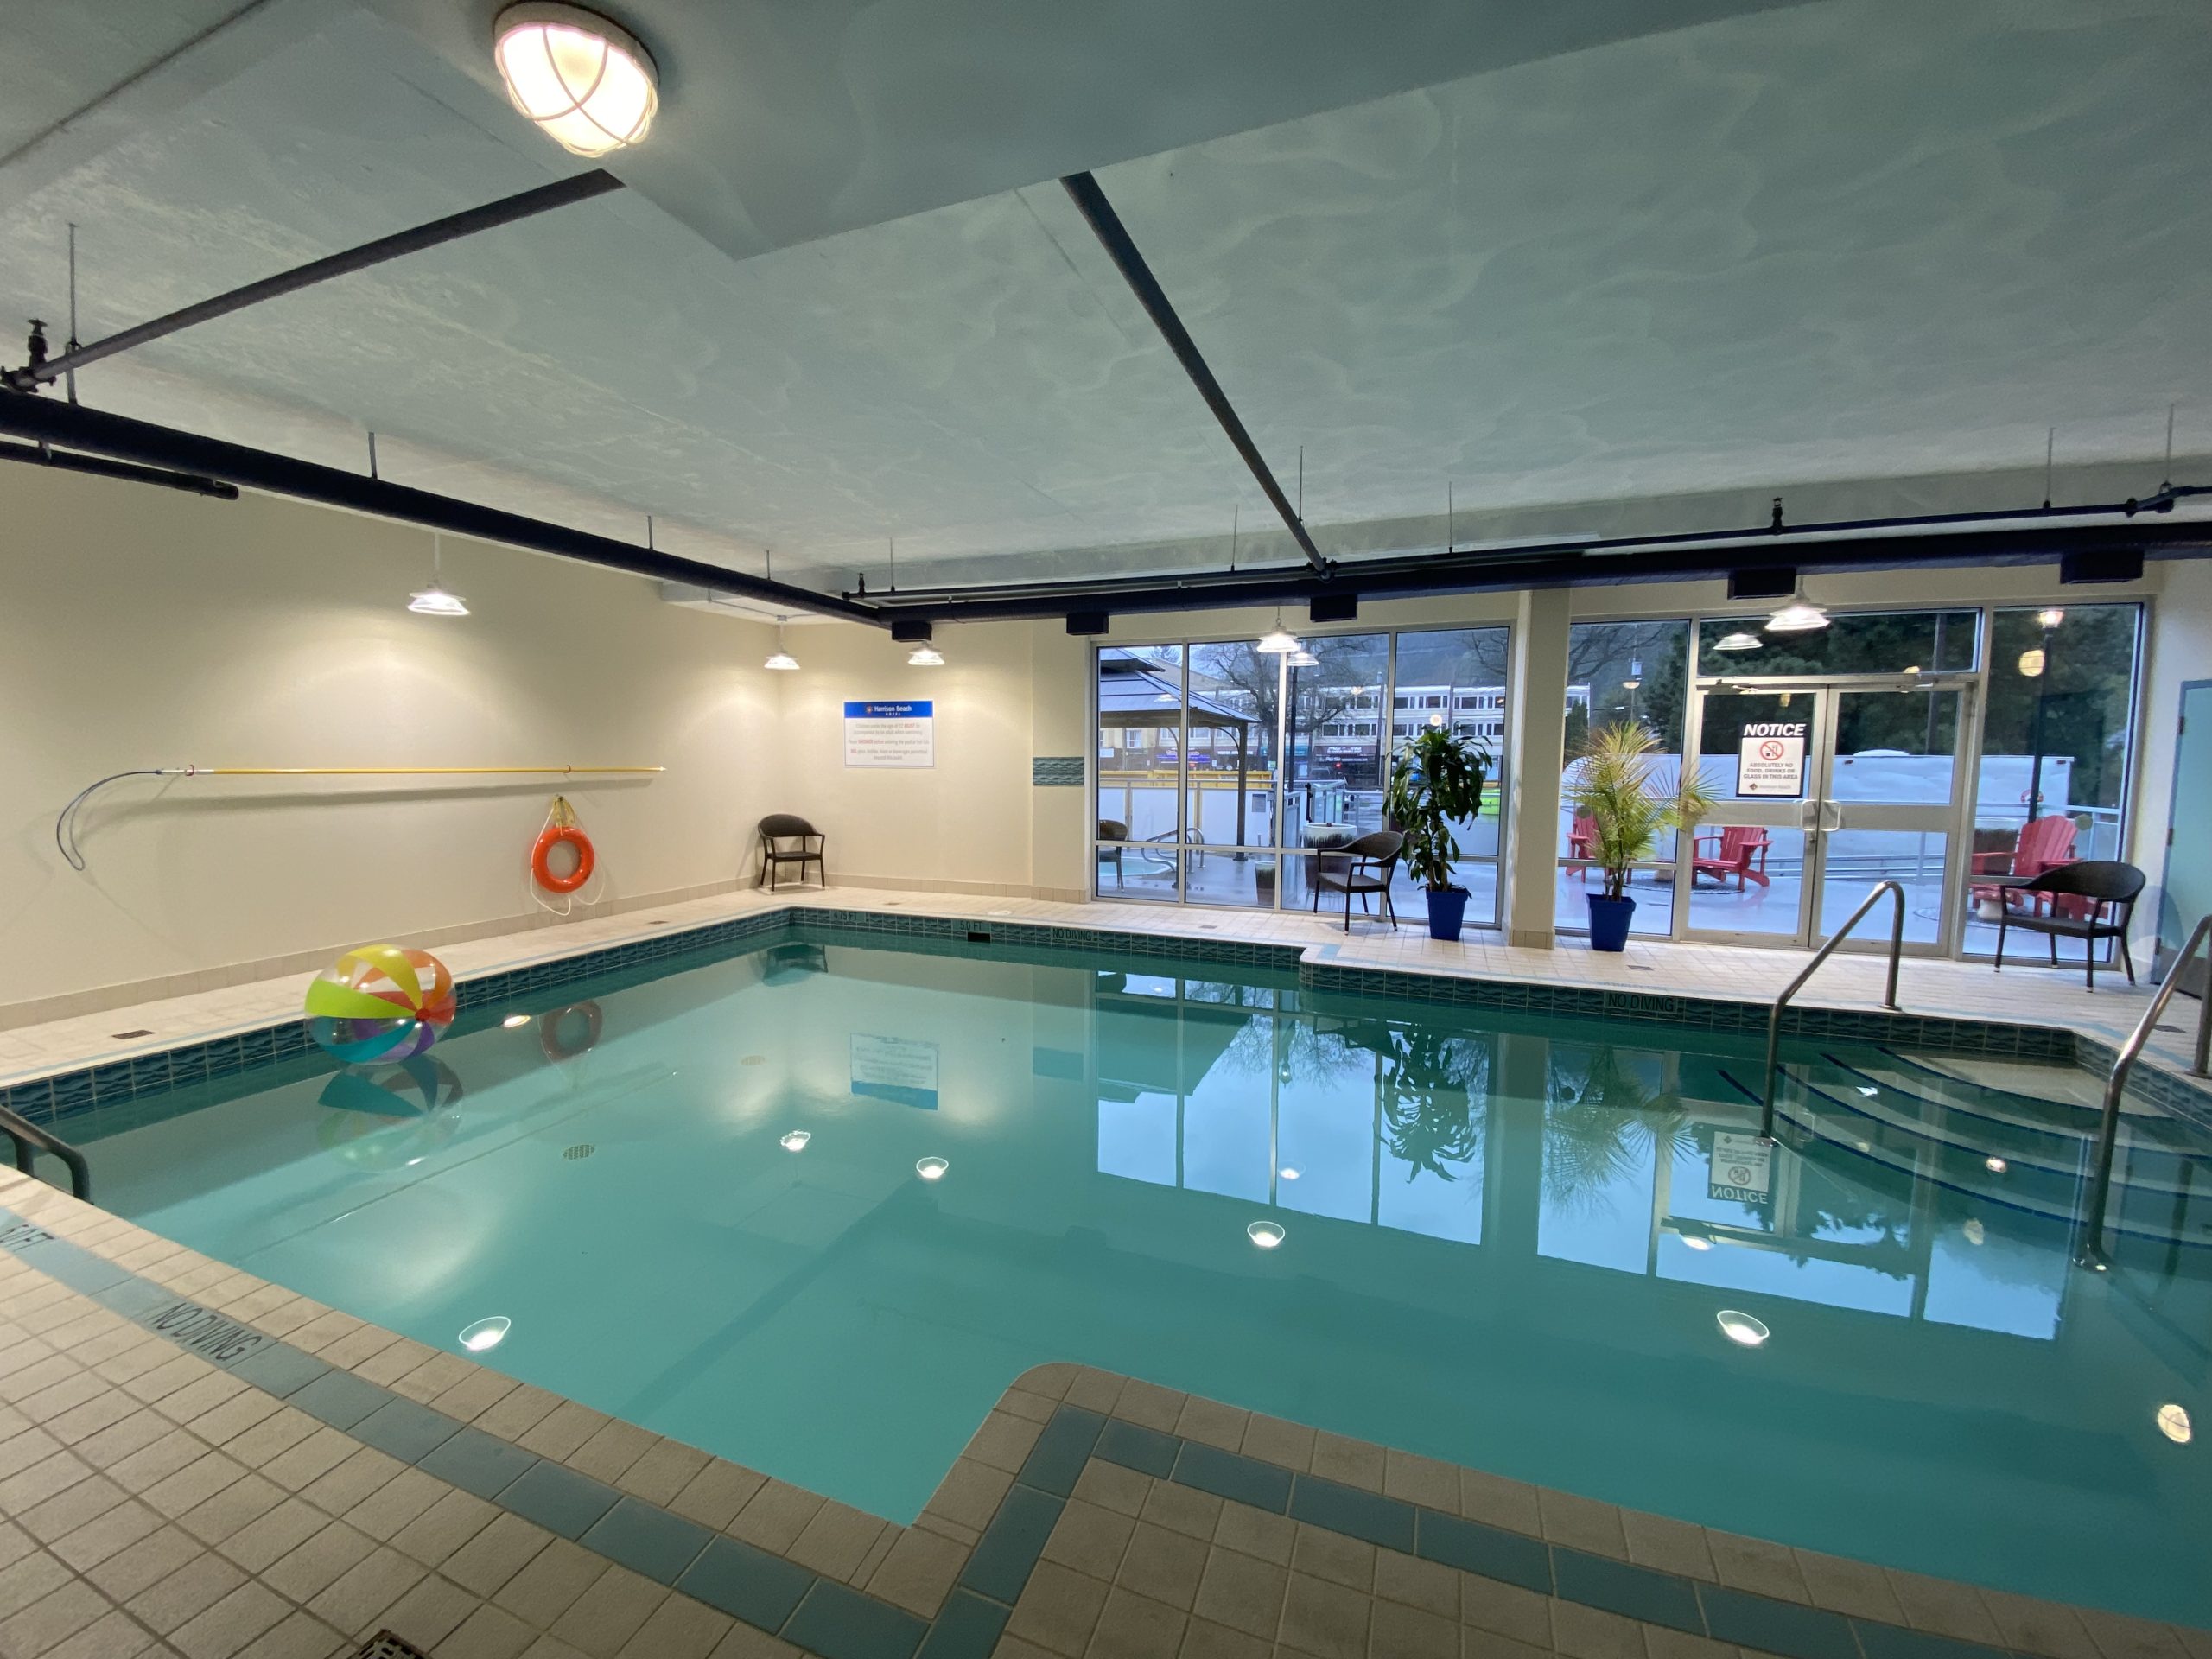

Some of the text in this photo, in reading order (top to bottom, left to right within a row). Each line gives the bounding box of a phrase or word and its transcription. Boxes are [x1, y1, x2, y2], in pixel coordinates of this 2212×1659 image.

[1744, 723, 1806, 736] NOTICE
[973, 921, 982, 931] FT
[1052, 928, 1091, 941] NO DIVING
[1609, 993, 1674, 1012] NO DIVING
[145, 1302, 263, 1362] NO DIVING
